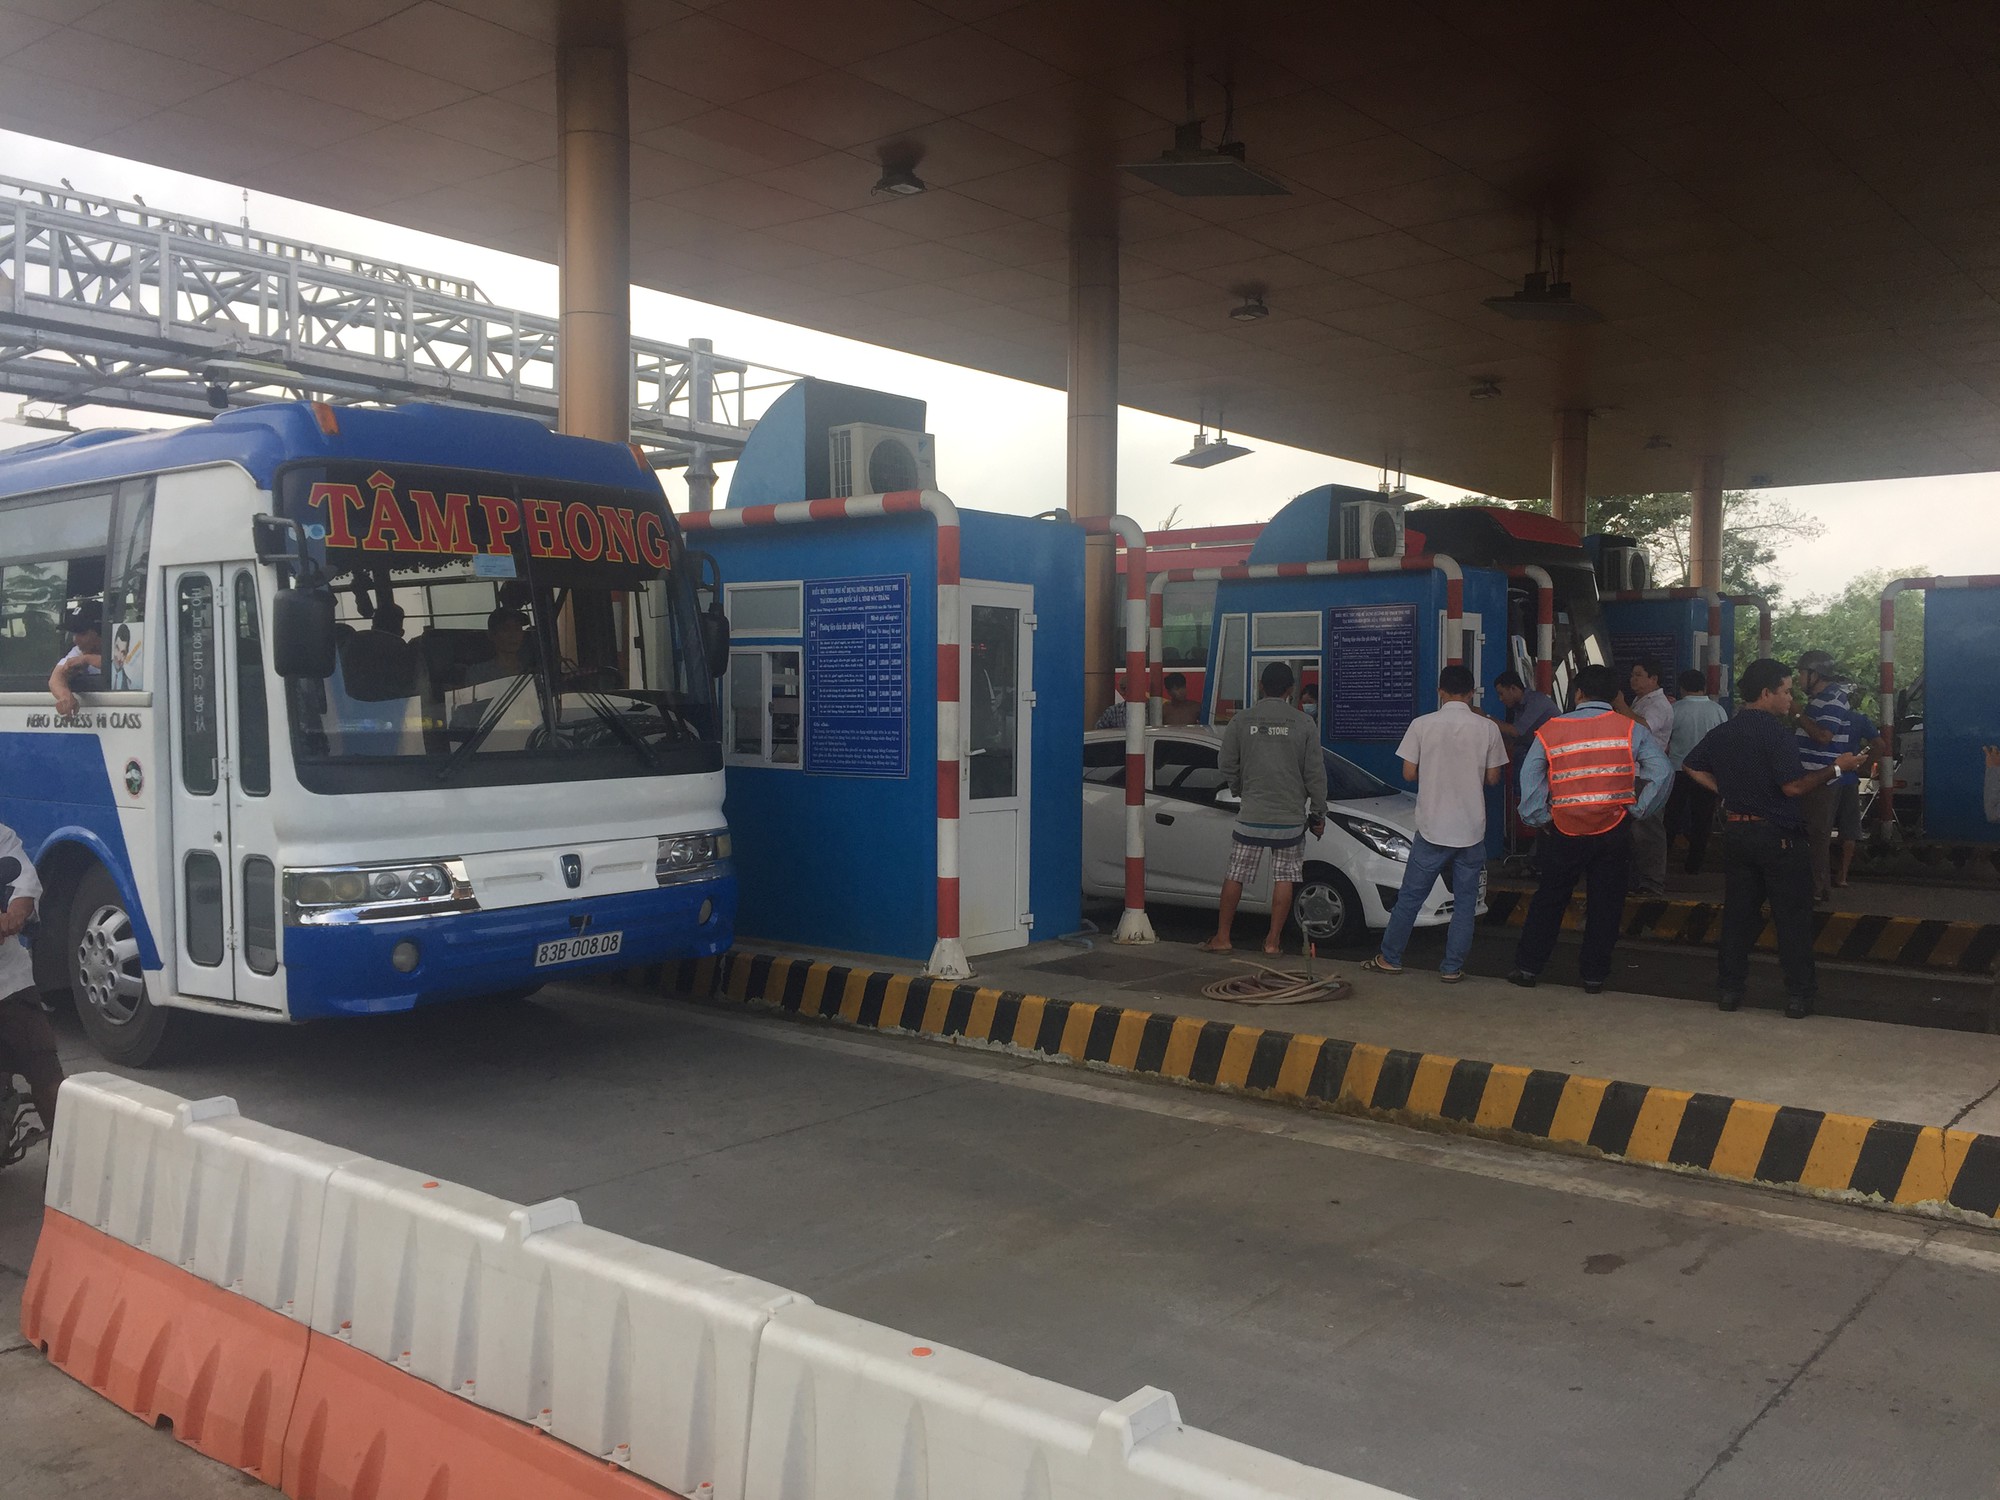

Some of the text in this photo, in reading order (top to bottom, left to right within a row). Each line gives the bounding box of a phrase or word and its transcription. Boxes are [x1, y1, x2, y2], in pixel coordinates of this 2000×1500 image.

[308, 470, 671, 570] TÂM PHONG
[110, 712, 142, 729] CLASS
[539, 934, 620, 963] 83B-008.08
